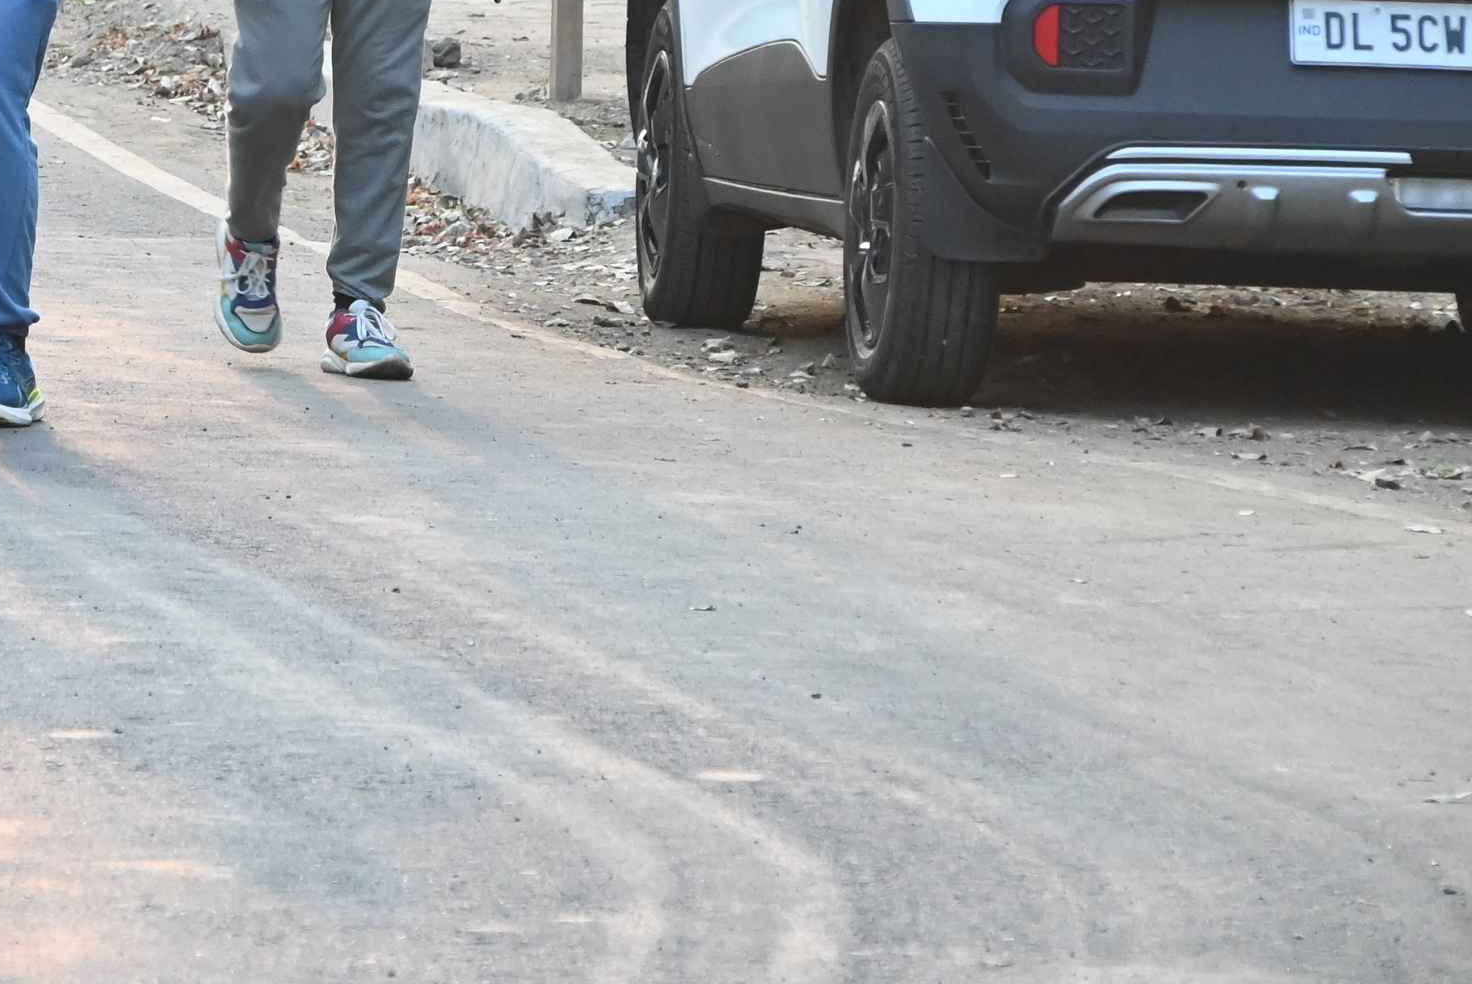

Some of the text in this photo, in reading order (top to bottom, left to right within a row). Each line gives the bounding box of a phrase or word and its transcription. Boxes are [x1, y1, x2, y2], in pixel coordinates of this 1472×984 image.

[1298, 24, 1321, 36] IND
[1324, 11, 1467, 54] DL 5CW
